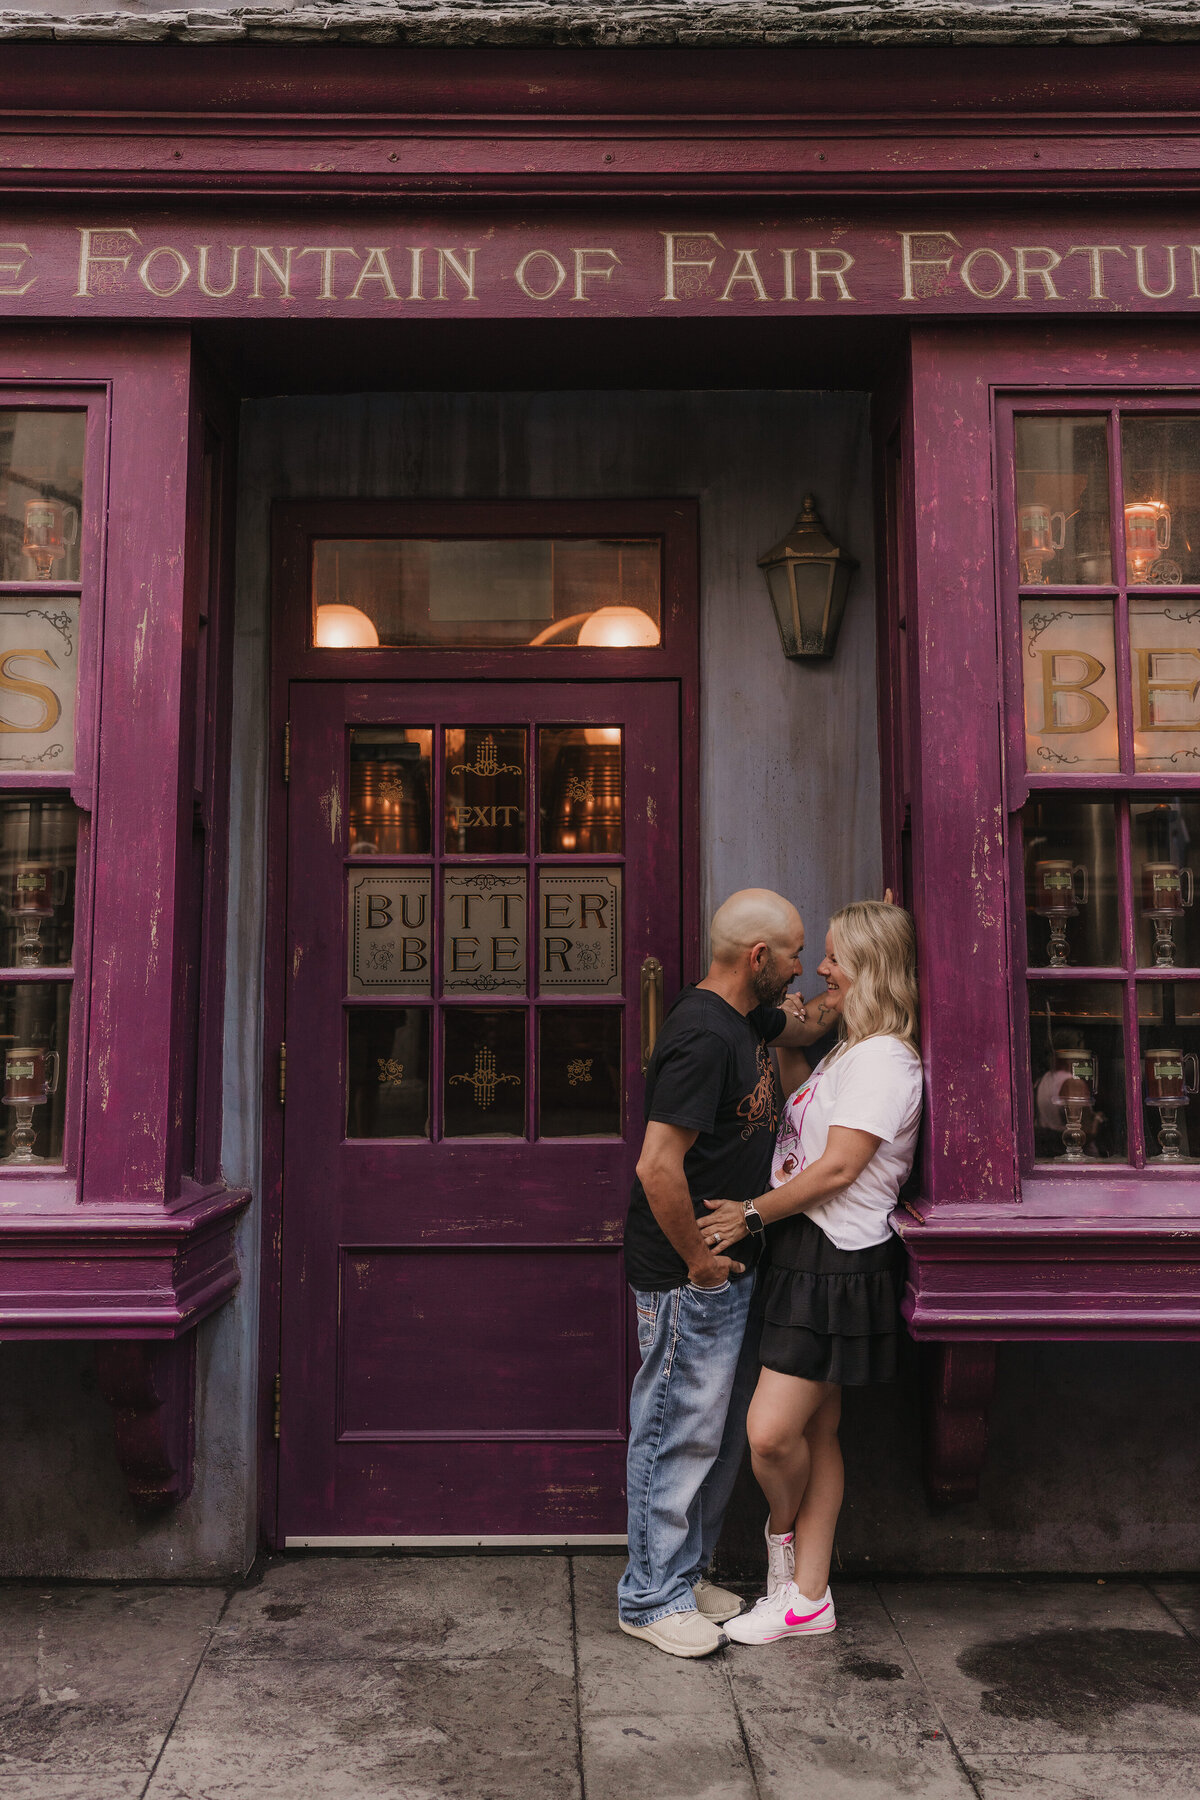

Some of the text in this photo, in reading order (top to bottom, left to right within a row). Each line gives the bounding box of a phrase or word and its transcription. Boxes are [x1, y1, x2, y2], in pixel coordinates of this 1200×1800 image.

[74, 226, 481, 301] FOUNTAIN
[514, 246, 623, 301] OF
[659, 230, 859, 302] FAIR
[454, 805, 519, 828] EXIT
[365, 893, 609, 930] BUTTER
[400, 936, 574, 973] BEER
